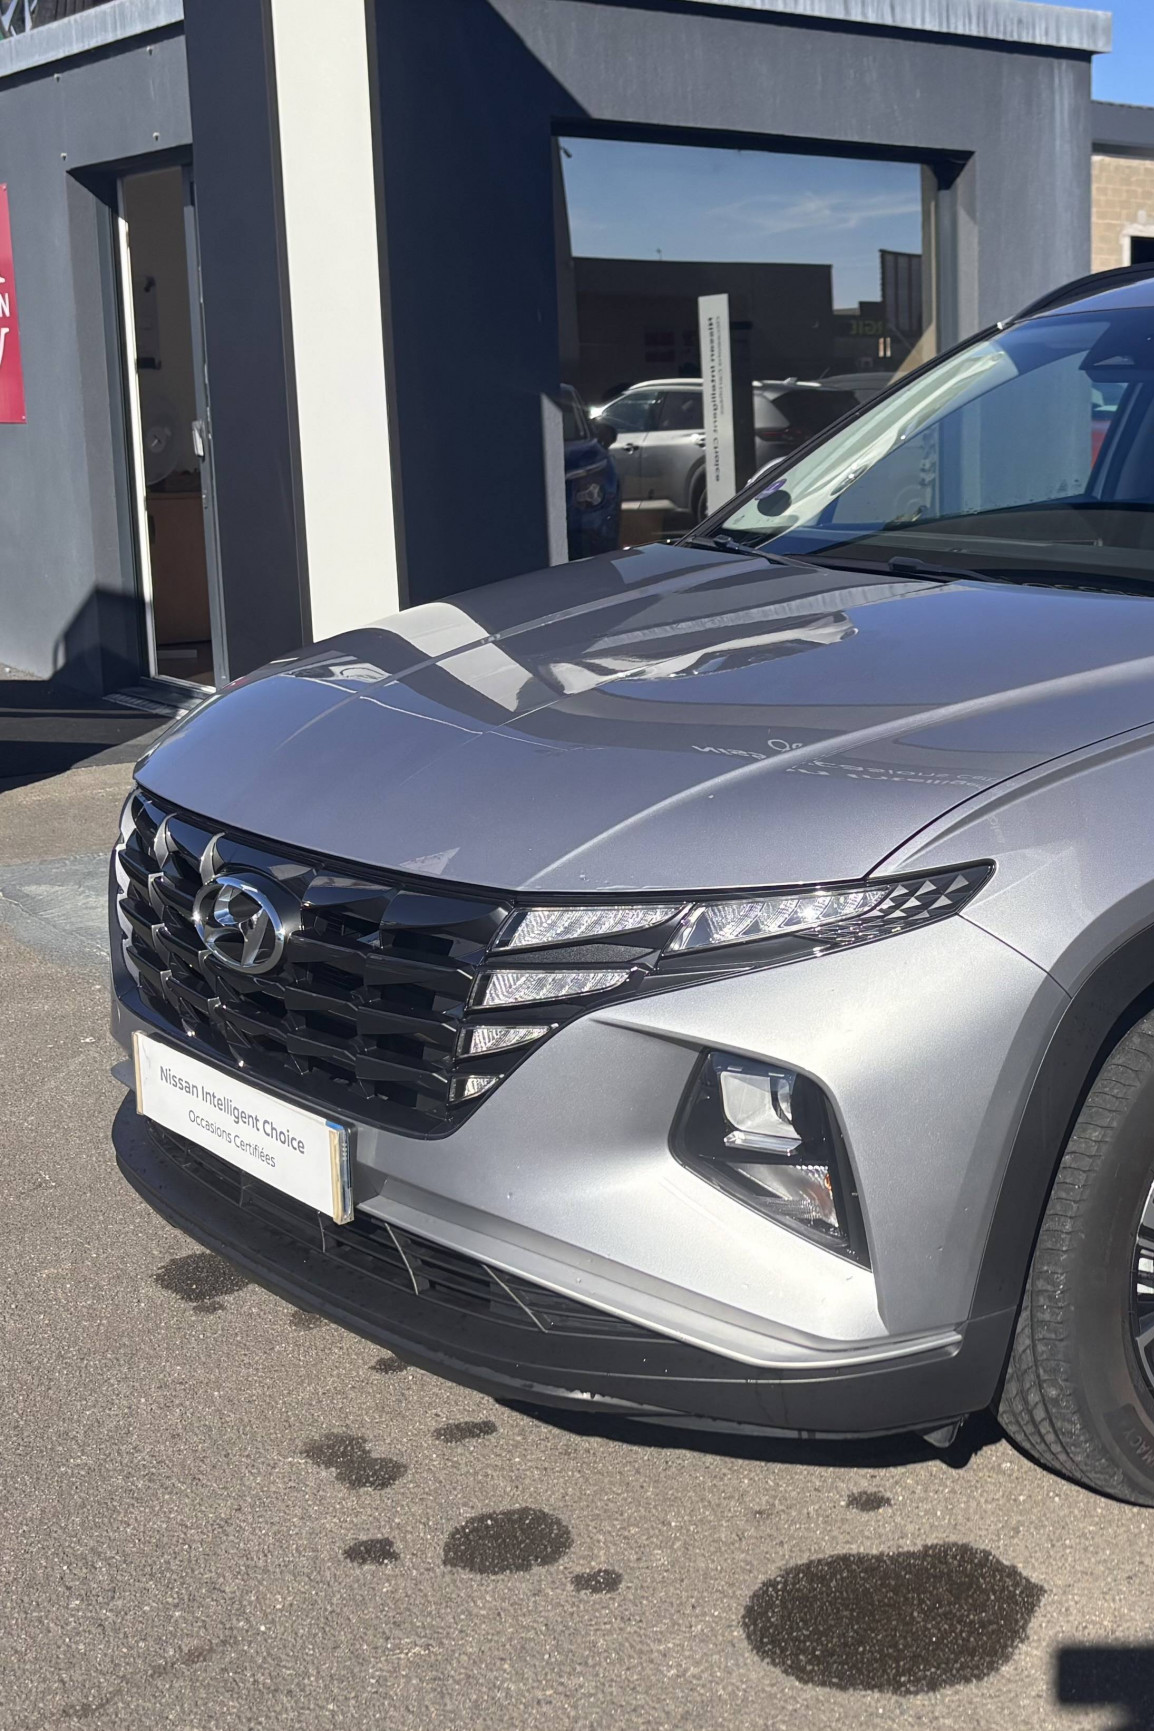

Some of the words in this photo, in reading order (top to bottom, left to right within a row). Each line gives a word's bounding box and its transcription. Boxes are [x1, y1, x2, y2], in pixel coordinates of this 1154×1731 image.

[159, 1066, 199, 1098] Nissan
[201, 1085, 260, 1132] Intelligent
[262, 1119, 305, 1155] Choice
[188, 1110, 232, 1144] Occasions
[233, 1135, 276, 1168] Certifiées
